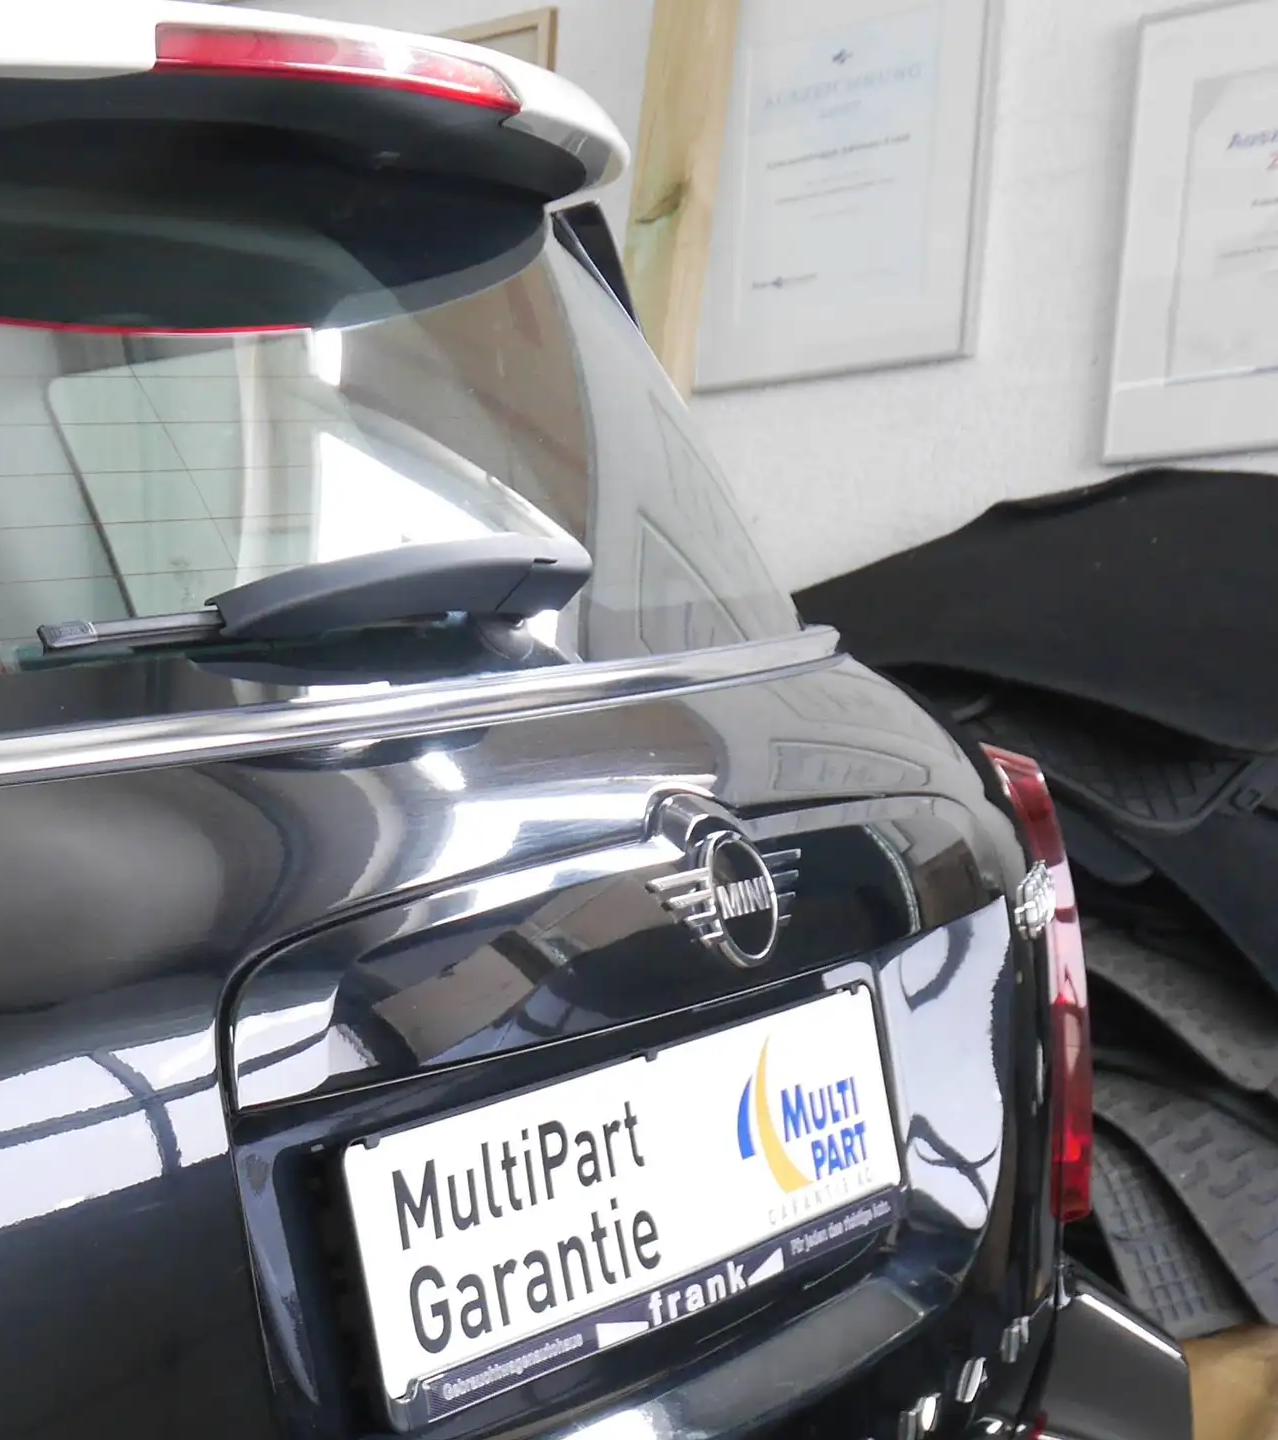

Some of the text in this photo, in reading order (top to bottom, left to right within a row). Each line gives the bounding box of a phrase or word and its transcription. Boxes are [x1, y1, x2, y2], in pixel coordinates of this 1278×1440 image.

[716, 875, 772, 920] MINI
[391, 1101, 645, 1251] MultiPart
[811, 1120, 869, 1181] PART
[409, 1199, 661, 1355] Garantie
[648, 1260, 747, 1327] frank
